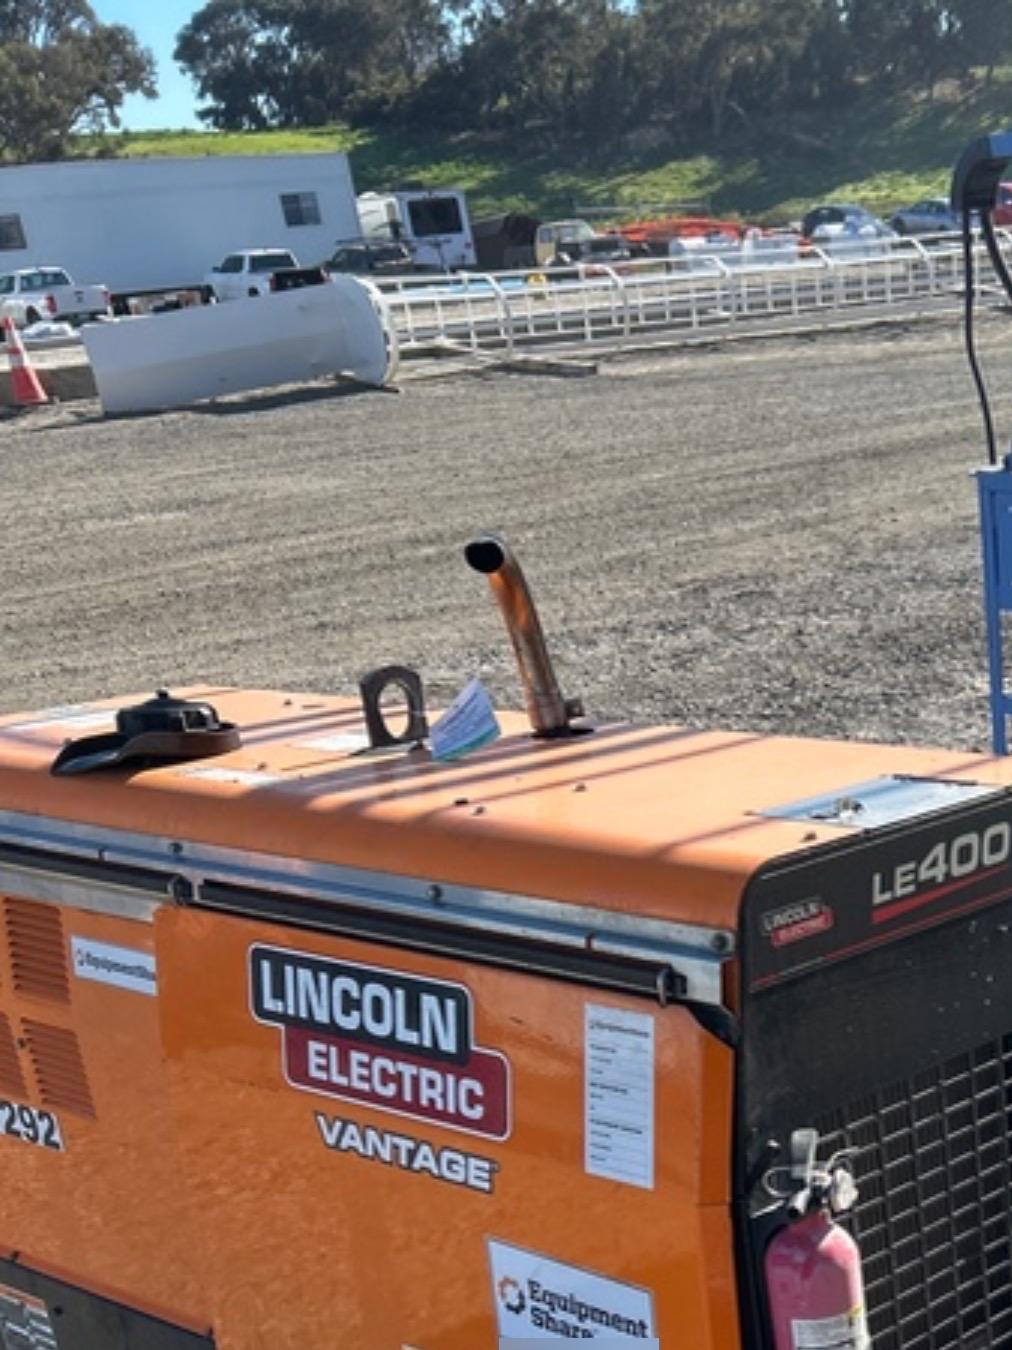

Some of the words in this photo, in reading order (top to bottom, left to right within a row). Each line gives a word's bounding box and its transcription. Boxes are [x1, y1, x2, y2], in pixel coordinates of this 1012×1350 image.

[872, 822, 1011, 905] LE400
[260, 960, 457, 1054] LINCOLN
[307, 1041, 485, 1121] ELECTRIC
[316, 1114, 494, 1193] VANTAGE
[527, 1279, 649, 1338] Equipment
